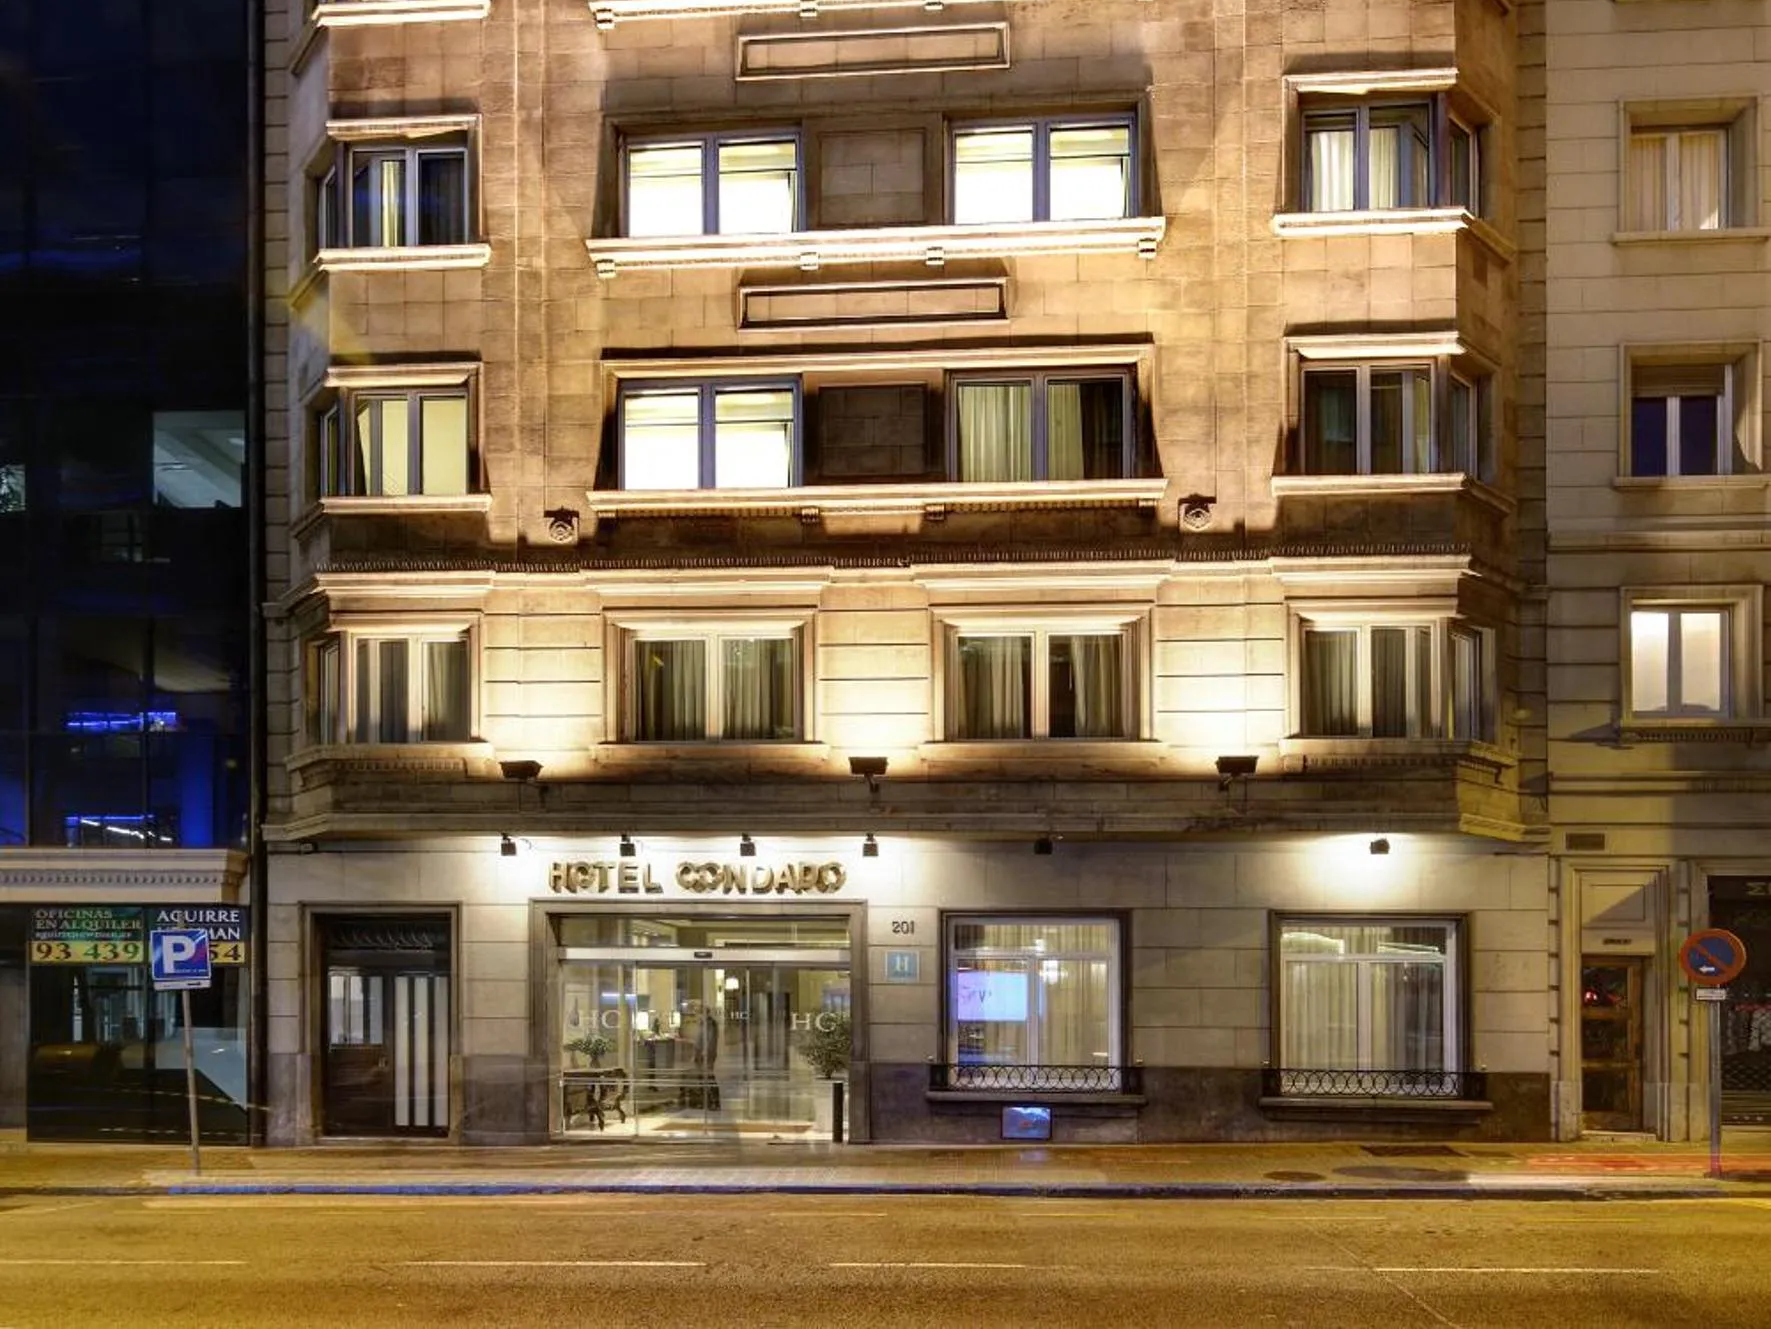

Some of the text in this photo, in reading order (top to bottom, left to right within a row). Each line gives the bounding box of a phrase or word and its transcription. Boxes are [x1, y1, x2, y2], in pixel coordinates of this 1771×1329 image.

[549, 860, 847, 894] HOTEL CONDADO
[35, 909, 113, 919] OFICINAS
[36, 920, 143, 931] EN ALQUILER
[891, 920, 915, 935] 201
[36, 943, 140, 960] 93 439
[163, 935, 197, 974] P
